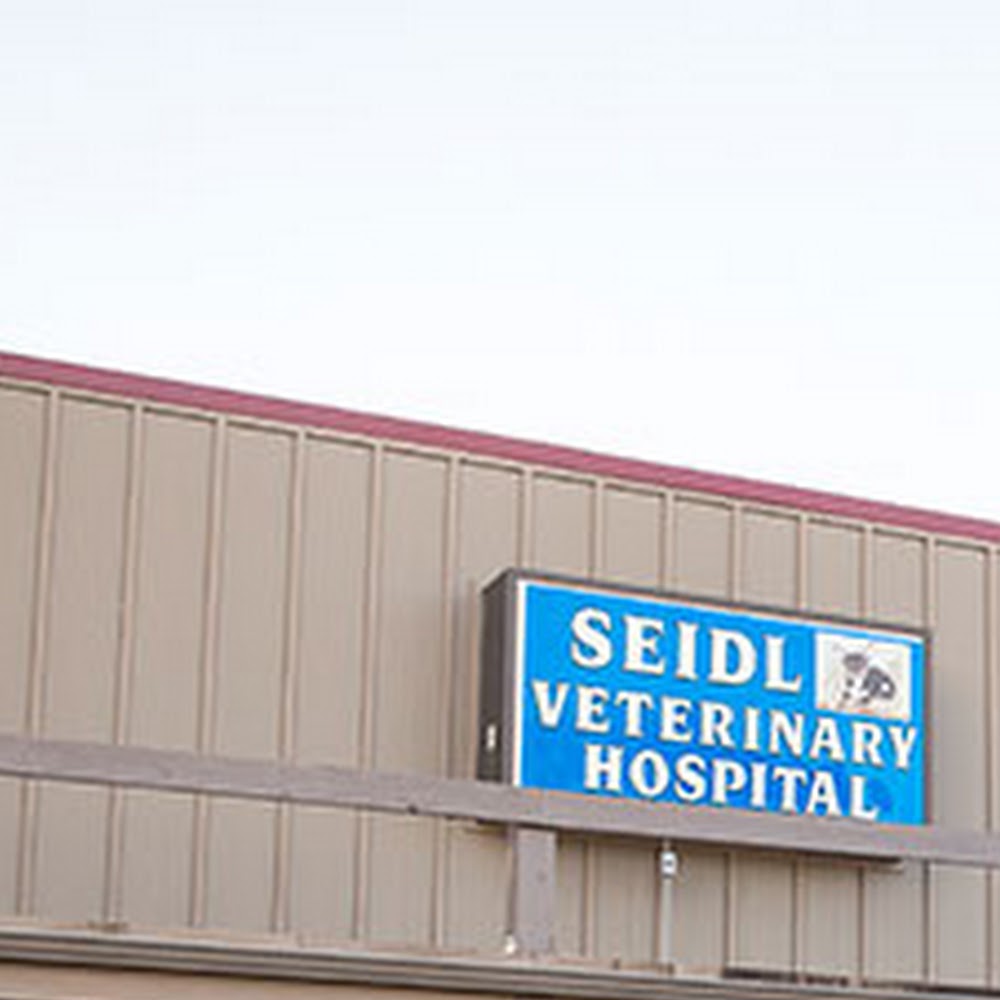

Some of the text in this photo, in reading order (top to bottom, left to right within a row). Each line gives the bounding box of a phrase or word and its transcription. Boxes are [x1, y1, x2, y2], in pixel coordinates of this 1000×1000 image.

[570, 606, 802, 693] SEIDL
[532, 680, 917, 771] VETERINARY
[584, 743, 881, 821] HOSPITAL
